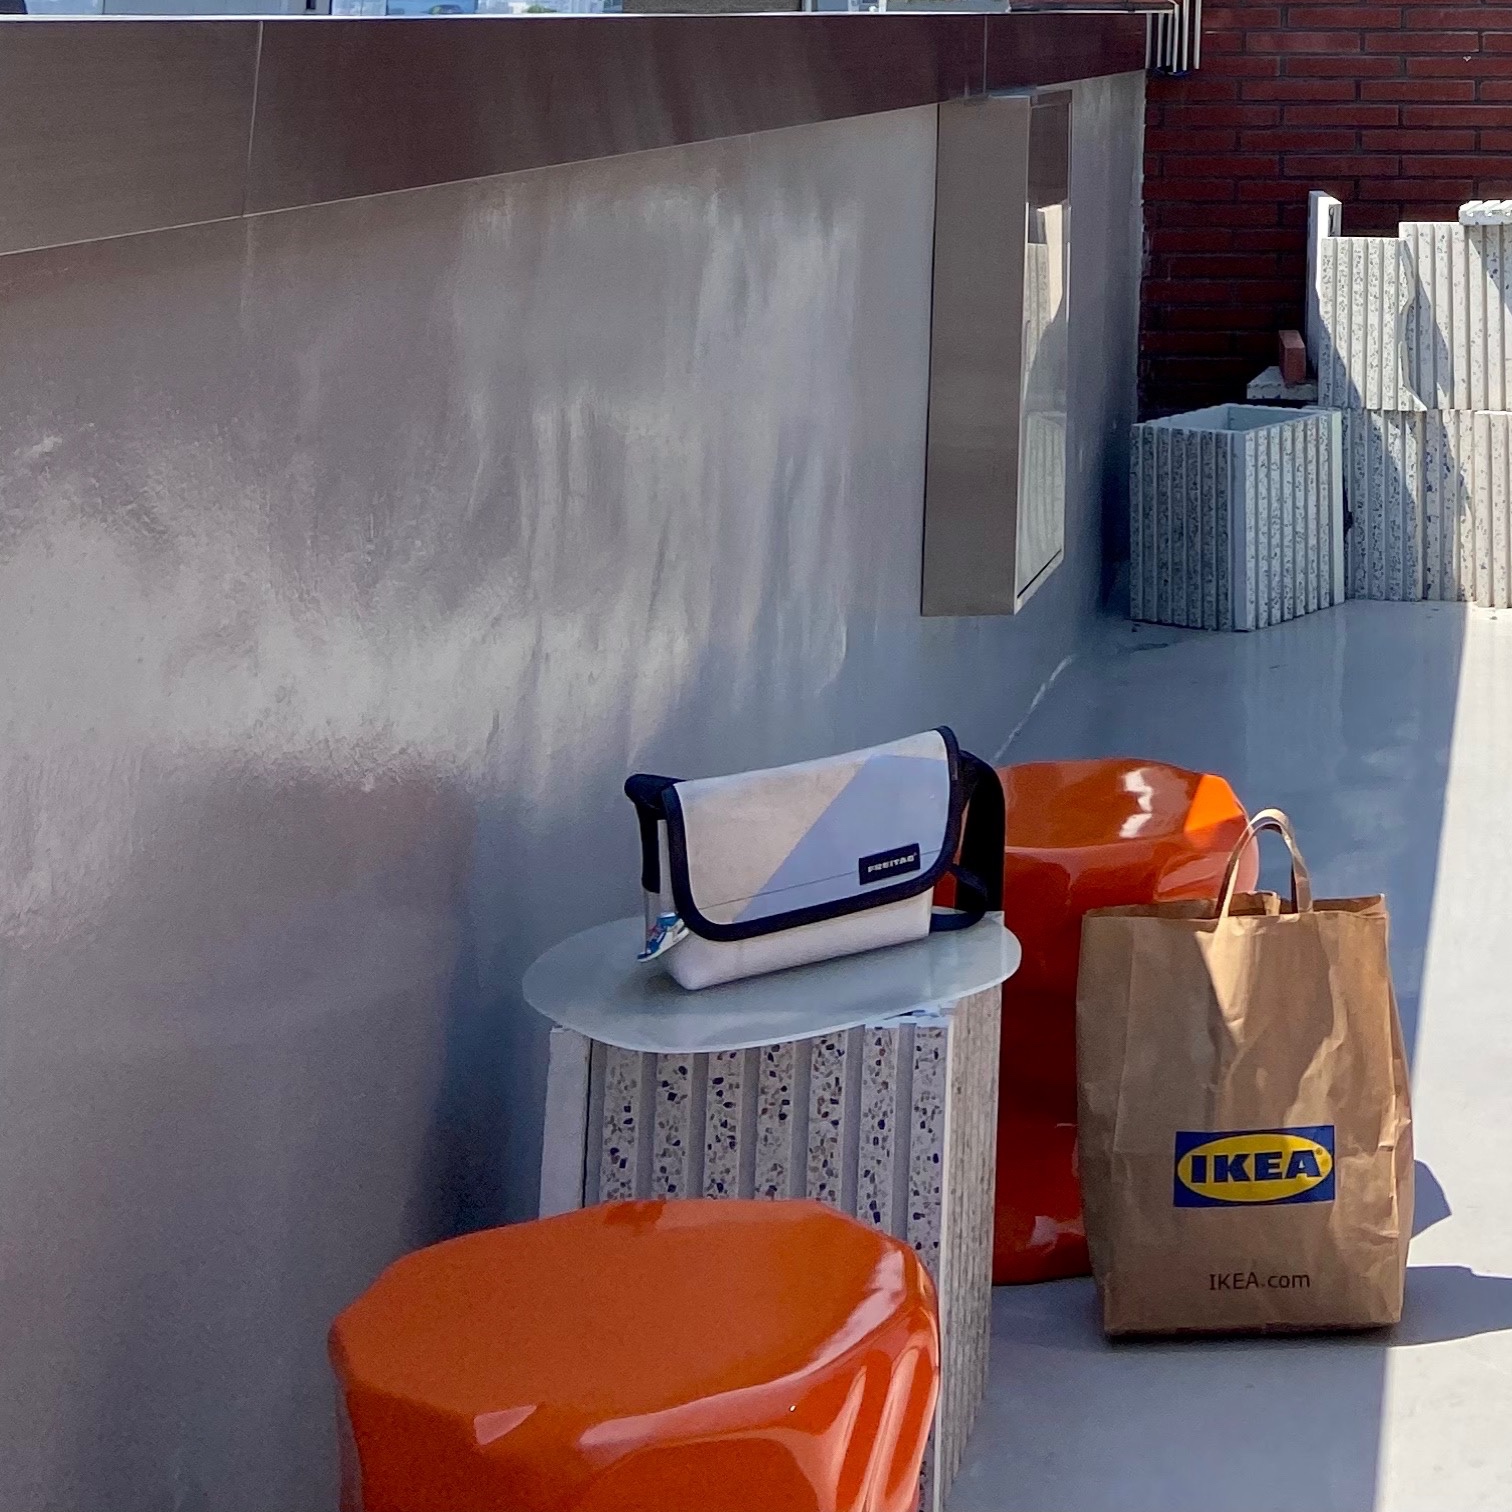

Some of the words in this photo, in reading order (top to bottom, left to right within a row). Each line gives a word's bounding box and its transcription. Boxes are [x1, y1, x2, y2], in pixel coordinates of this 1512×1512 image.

[867, 854, 915, 873] FREITAG
[1190, 1149, 1322, 1184] IKEA
[1209, 1271, 1311, 1291] IKEA.com
